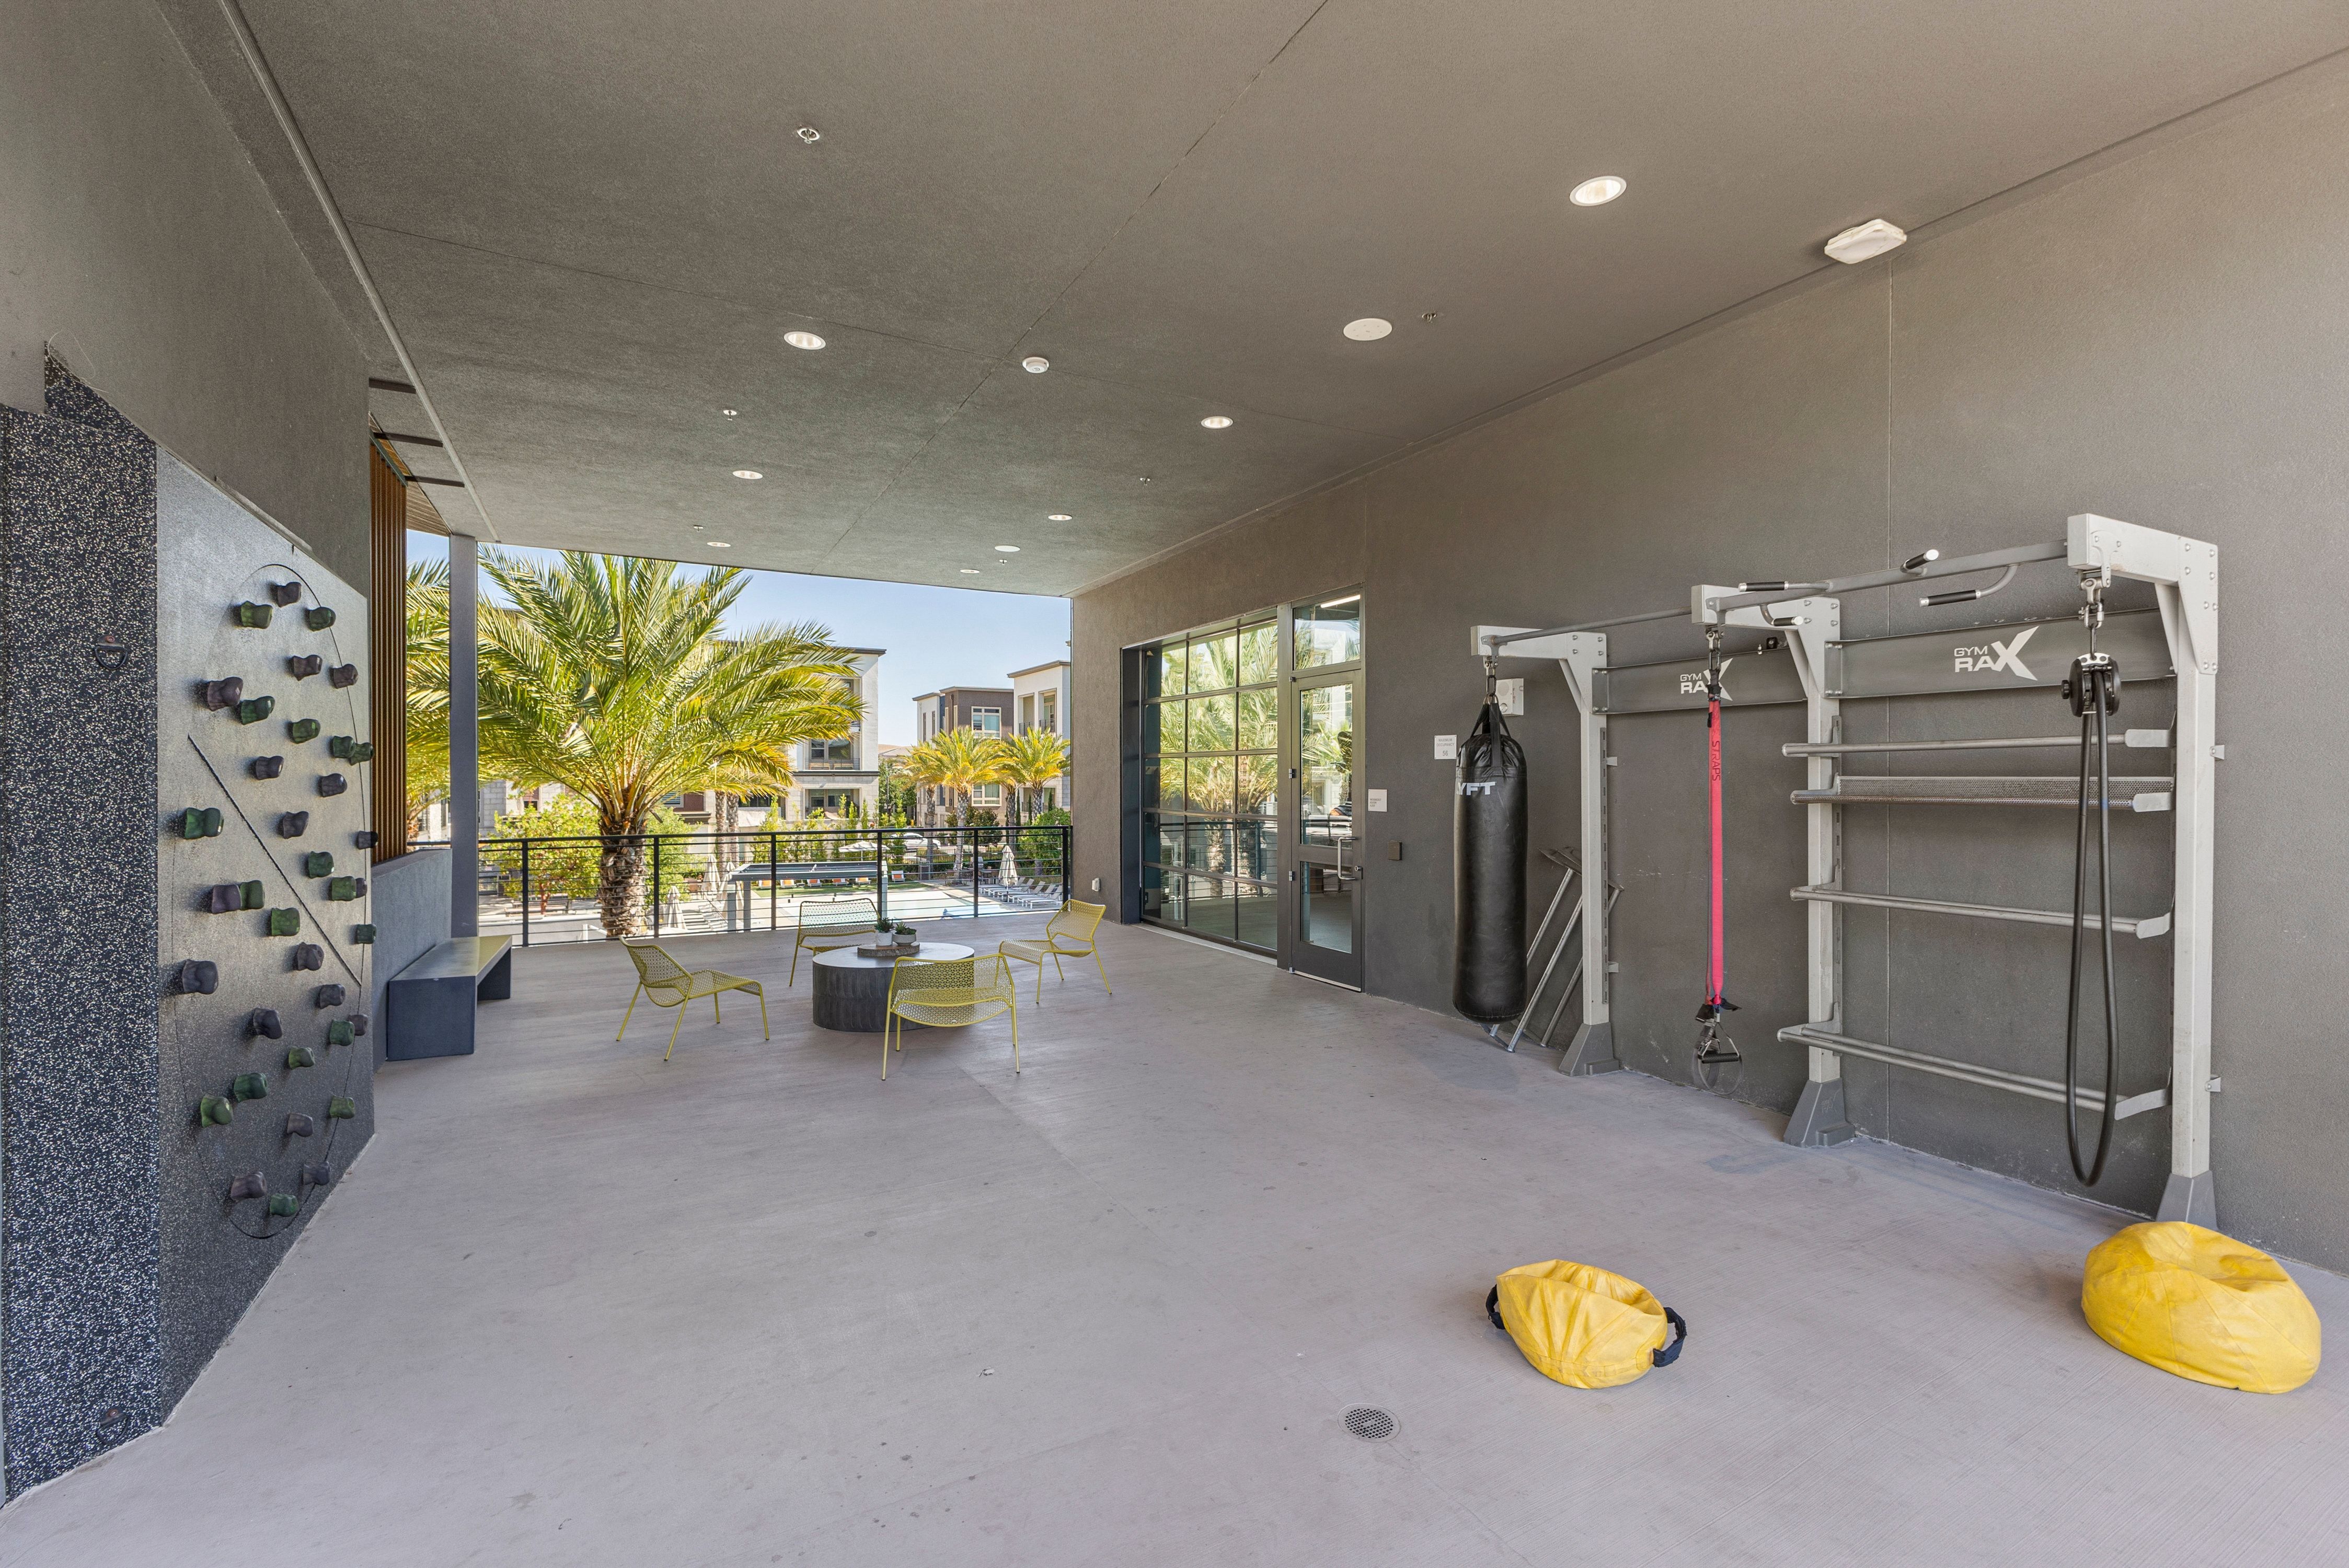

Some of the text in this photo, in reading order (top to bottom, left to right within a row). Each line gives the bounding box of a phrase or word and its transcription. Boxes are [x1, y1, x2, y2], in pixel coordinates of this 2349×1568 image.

[1954, 645, 1988, 657] GYM
[1954, 625, 2039, 681] RAX
[1680, 673, 1702, 682] GYM
[1712, 741, 1721, 781] STRAPS
